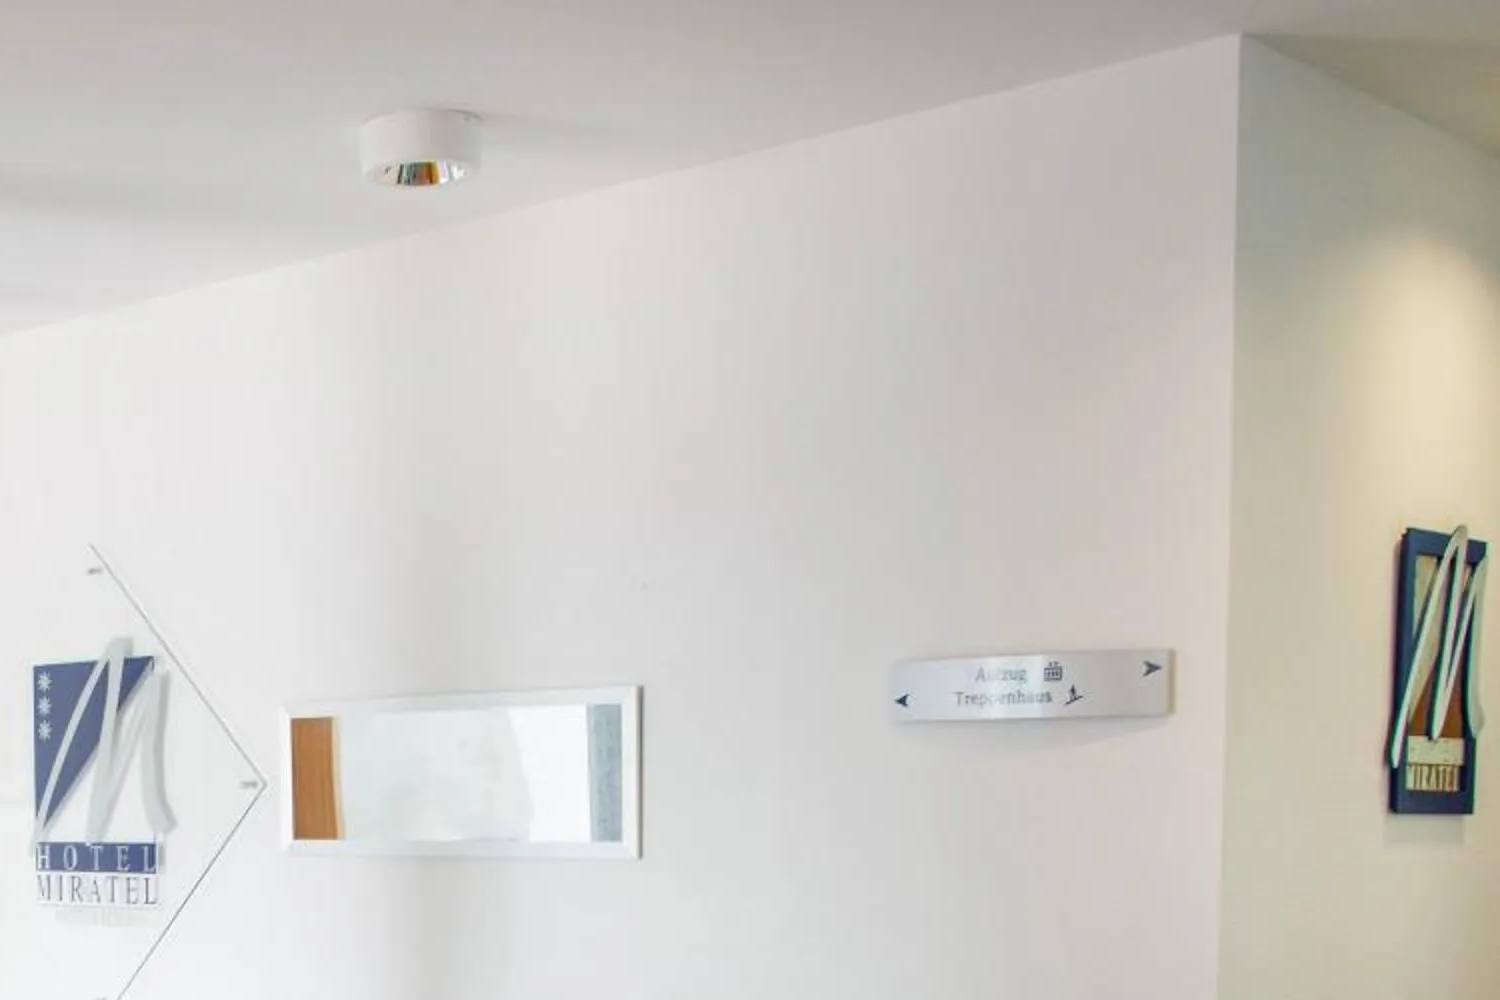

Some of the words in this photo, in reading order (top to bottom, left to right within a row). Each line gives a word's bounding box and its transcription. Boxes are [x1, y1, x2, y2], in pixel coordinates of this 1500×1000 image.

[974, 666, 1028, 684] Azug
[36, 844, 156, 872] HOTEL
[36, 873, 159, 905] MIRATEL
